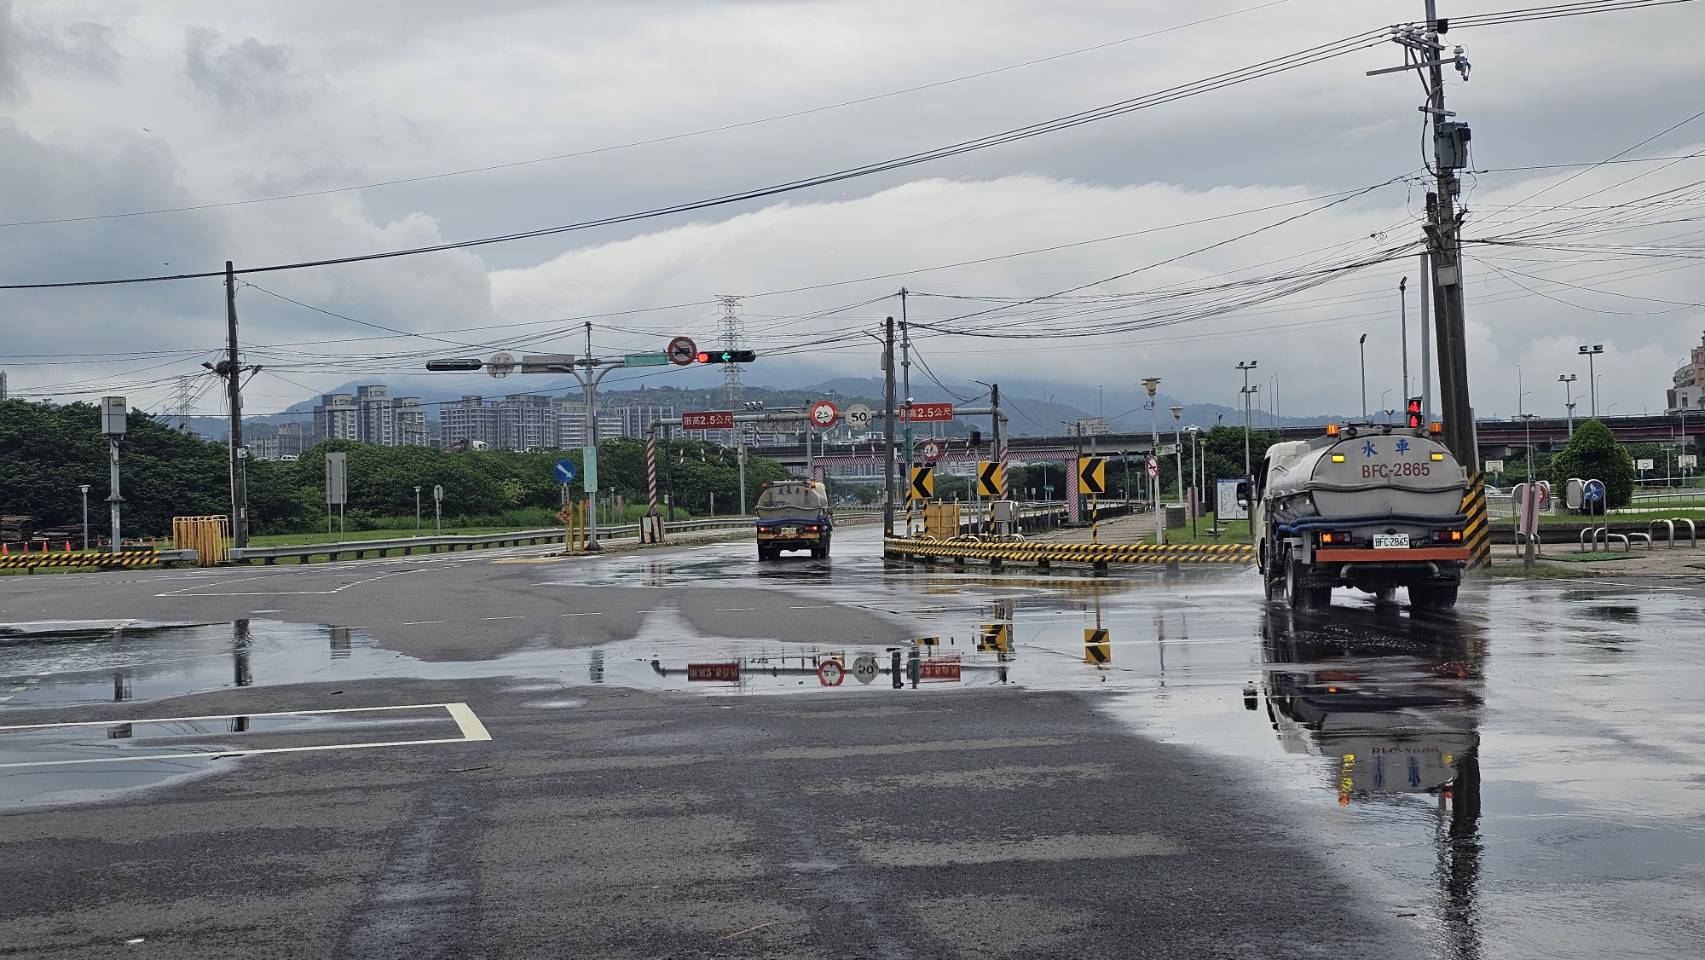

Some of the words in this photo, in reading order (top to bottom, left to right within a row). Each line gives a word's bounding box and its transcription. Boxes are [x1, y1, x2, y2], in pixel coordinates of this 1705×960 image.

[684, 415, 732, 426] 限高2.5公尺
[851, 412, 868, 422] 50
[1362, 462, 1430, 478] BFC-2865
